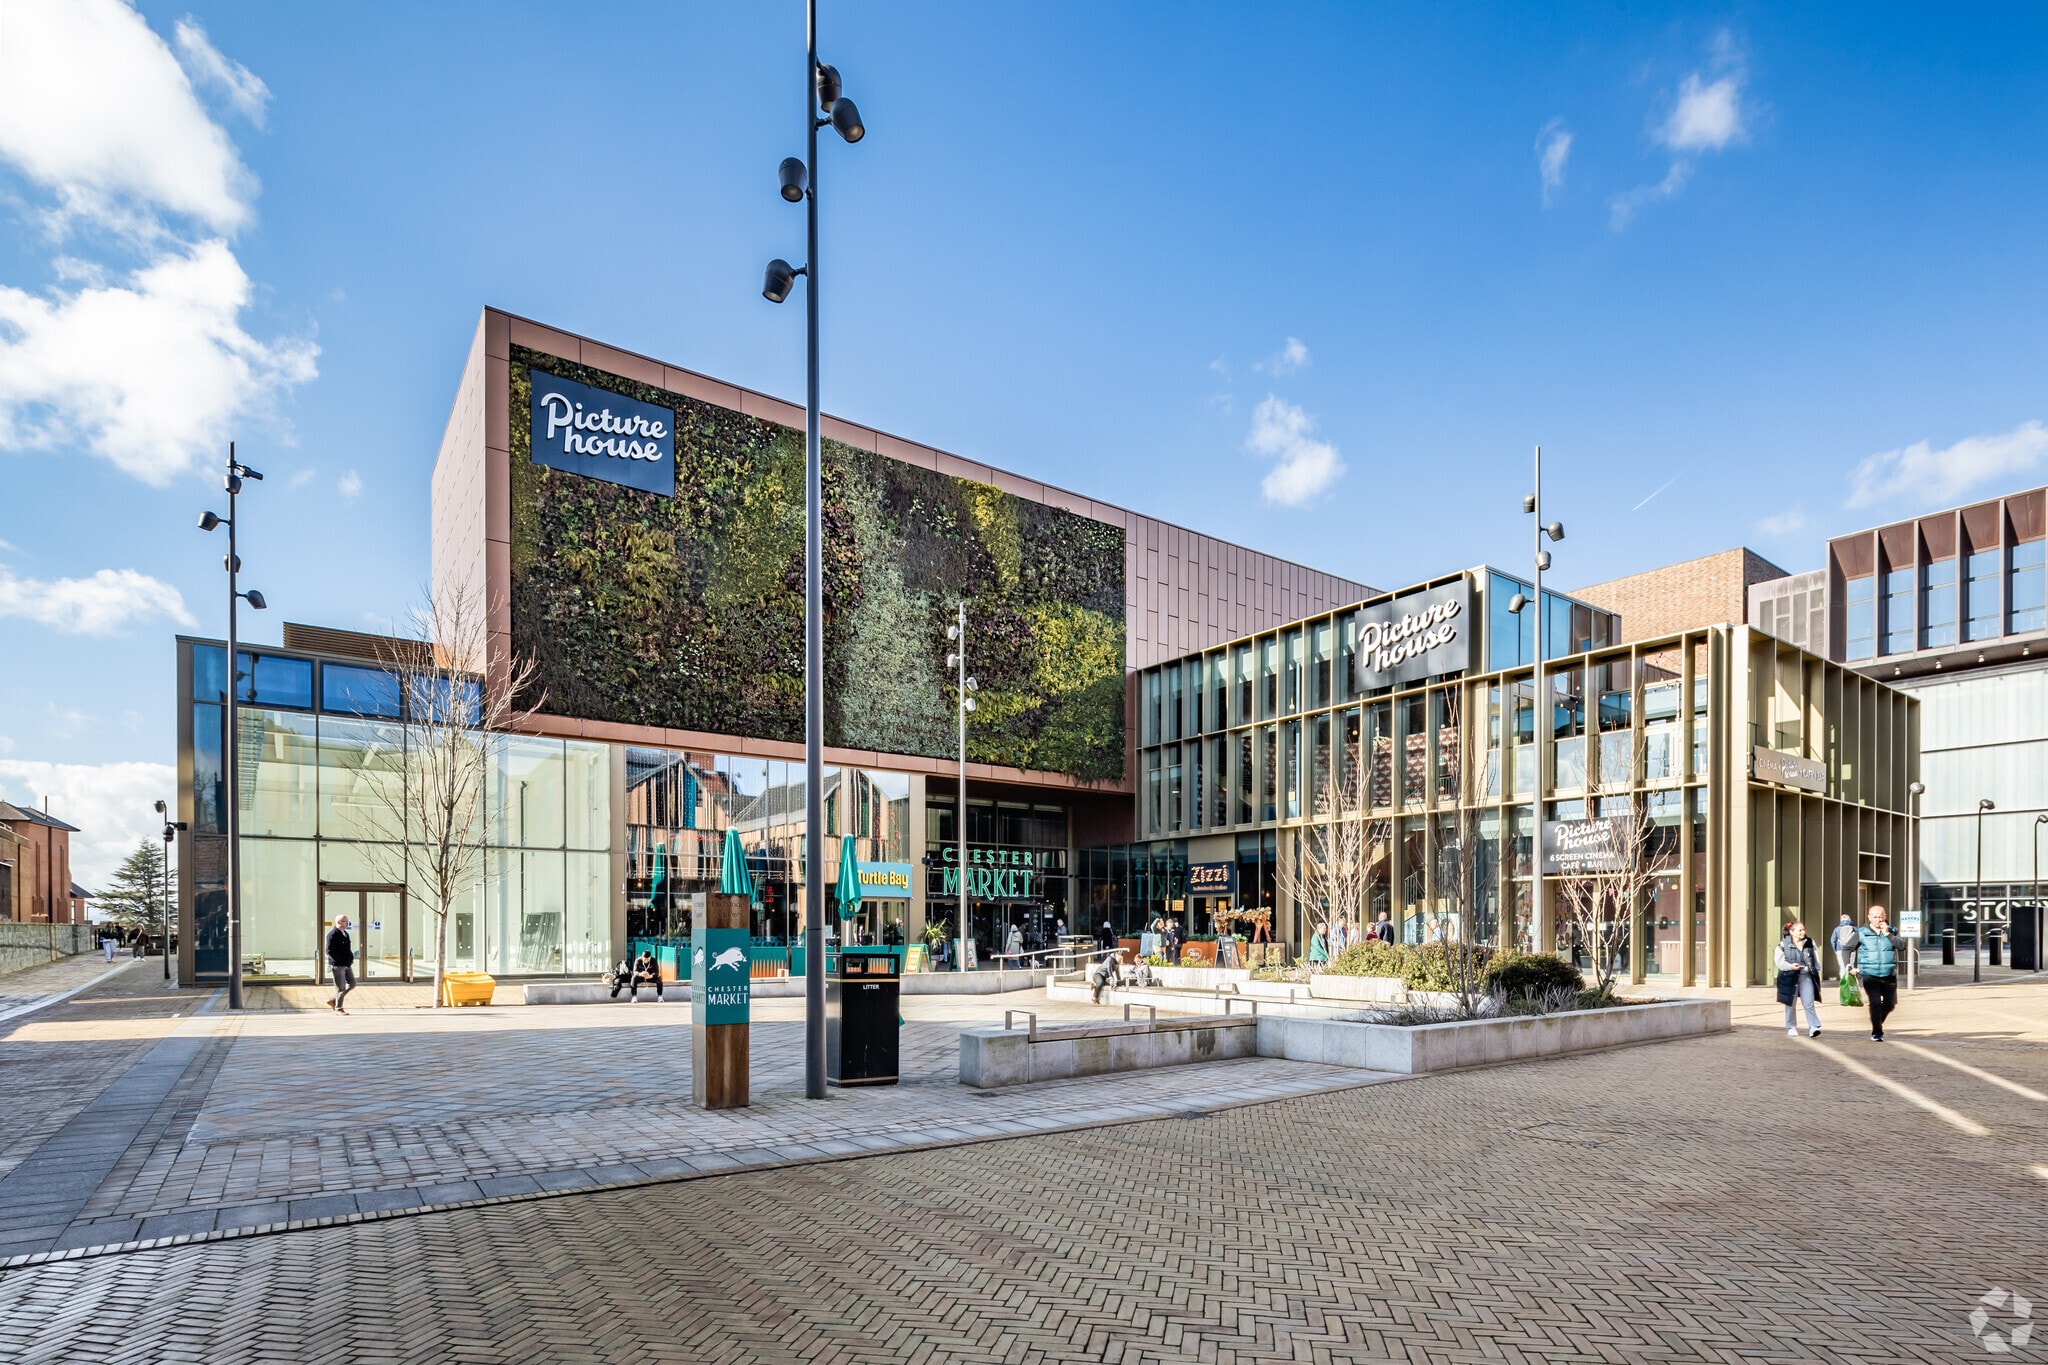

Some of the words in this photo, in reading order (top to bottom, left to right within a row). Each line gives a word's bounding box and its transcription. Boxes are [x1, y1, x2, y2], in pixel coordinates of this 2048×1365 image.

[540, 392, 668, 440] Picture
[563, 425, 663, 462] house
[1358, 598, 1461, 668] Picture
[1374, 623, 1457, 673] house
[1554, 819, 1613, 847] Picture
[1563, 831, 1611, 850] house
[942, 847, 1034, 866] CESTER
[1555, 852, 1584, 862] SCREEN
[1584, 851, 1616, 861] CINEMA
[1587, 860, 1603, 869] BAR
[857, 869, 888, 886] Turtle
[889, 871, 909, 890] Bay
[943, 866, 1034, 901] MARKET
[1190, 864, 1230, 884] Zizzi
[707, 985, 749, 993] CHESTER
[707, 993, 749, 1006] MARKET
